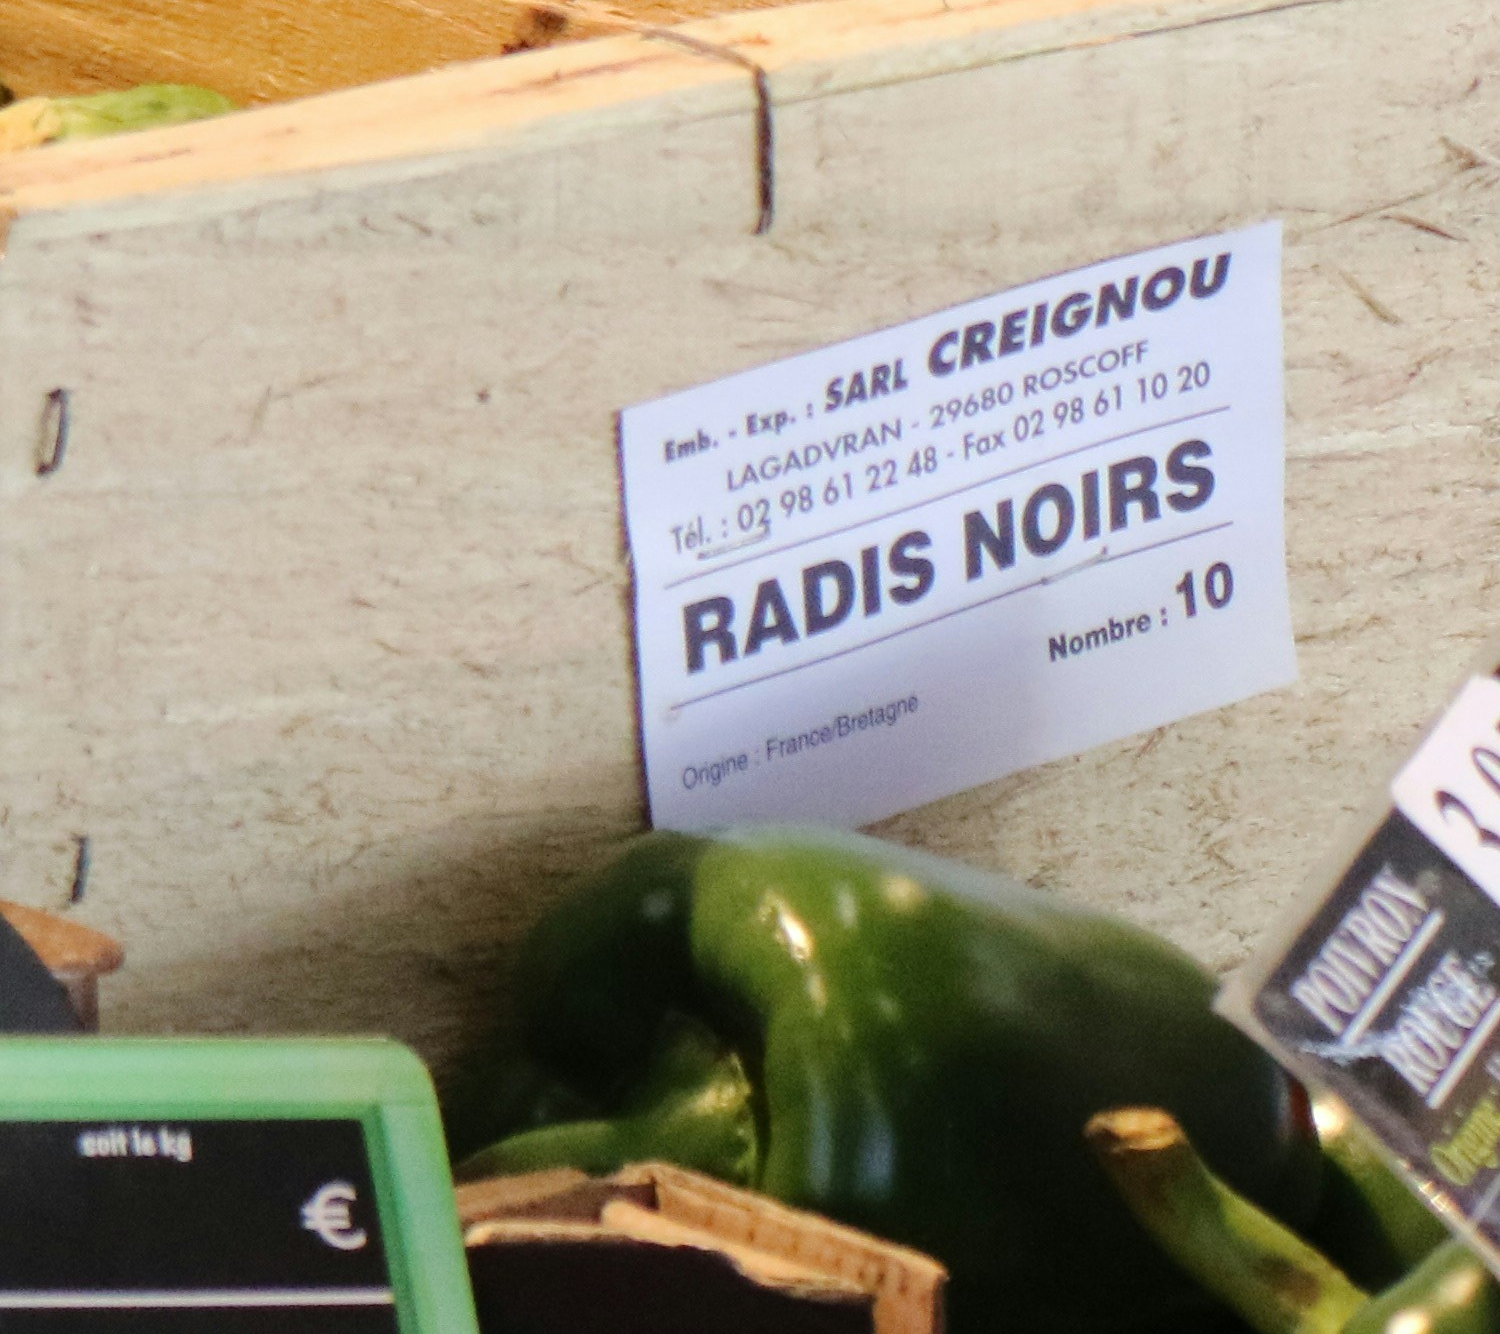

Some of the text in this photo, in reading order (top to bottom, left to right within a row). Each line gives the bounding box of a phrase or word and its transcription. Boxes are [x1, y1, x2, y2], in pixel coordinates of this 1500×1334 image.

[663, 428, 719, 464] Emb.
[745, 410, 797, 436] Exp.
[824, 357, 908, 413] SARL
[927, 251, 1233, 378] CREIGNOU
[726, 417, 902, 492] LAGADVRAN
[928, 380, 1015, 430] 29680
[1022, 338, 1150, 398] ROSCOFF
[668, 515, 712, 554] Tél.
[736, 497, 771, 532] 02
[778, 484, 814, 518] 98
[822, 472, 853, 506] 61
[864, 458, 898, 493] 22
[907, 445, 938, 478] 48
[962, 429, 1007, 462] Fax
[1013, 408, 1045, 443] 02
[1052, 395, 1085, 429] 98
[1093, 383, 1123, 417] 61
[1137, 371, 1169, 404] 10
[1176, 360, 1211, 392] 20
[682, 438, 1218, 675] RADIS NOIRS
[1047, 609, 1152, 663] Nombre
[1174, 561, 1236, 619] 10
[681, 748, 750, 792] Origine
[764, 693, 921, 762] France/Bretagne
[1291, 862, 1430, 1035] POIVRON
[1381, 950, 1499, 1096] ROUGE
[301, 1178, 368, 1251] €
